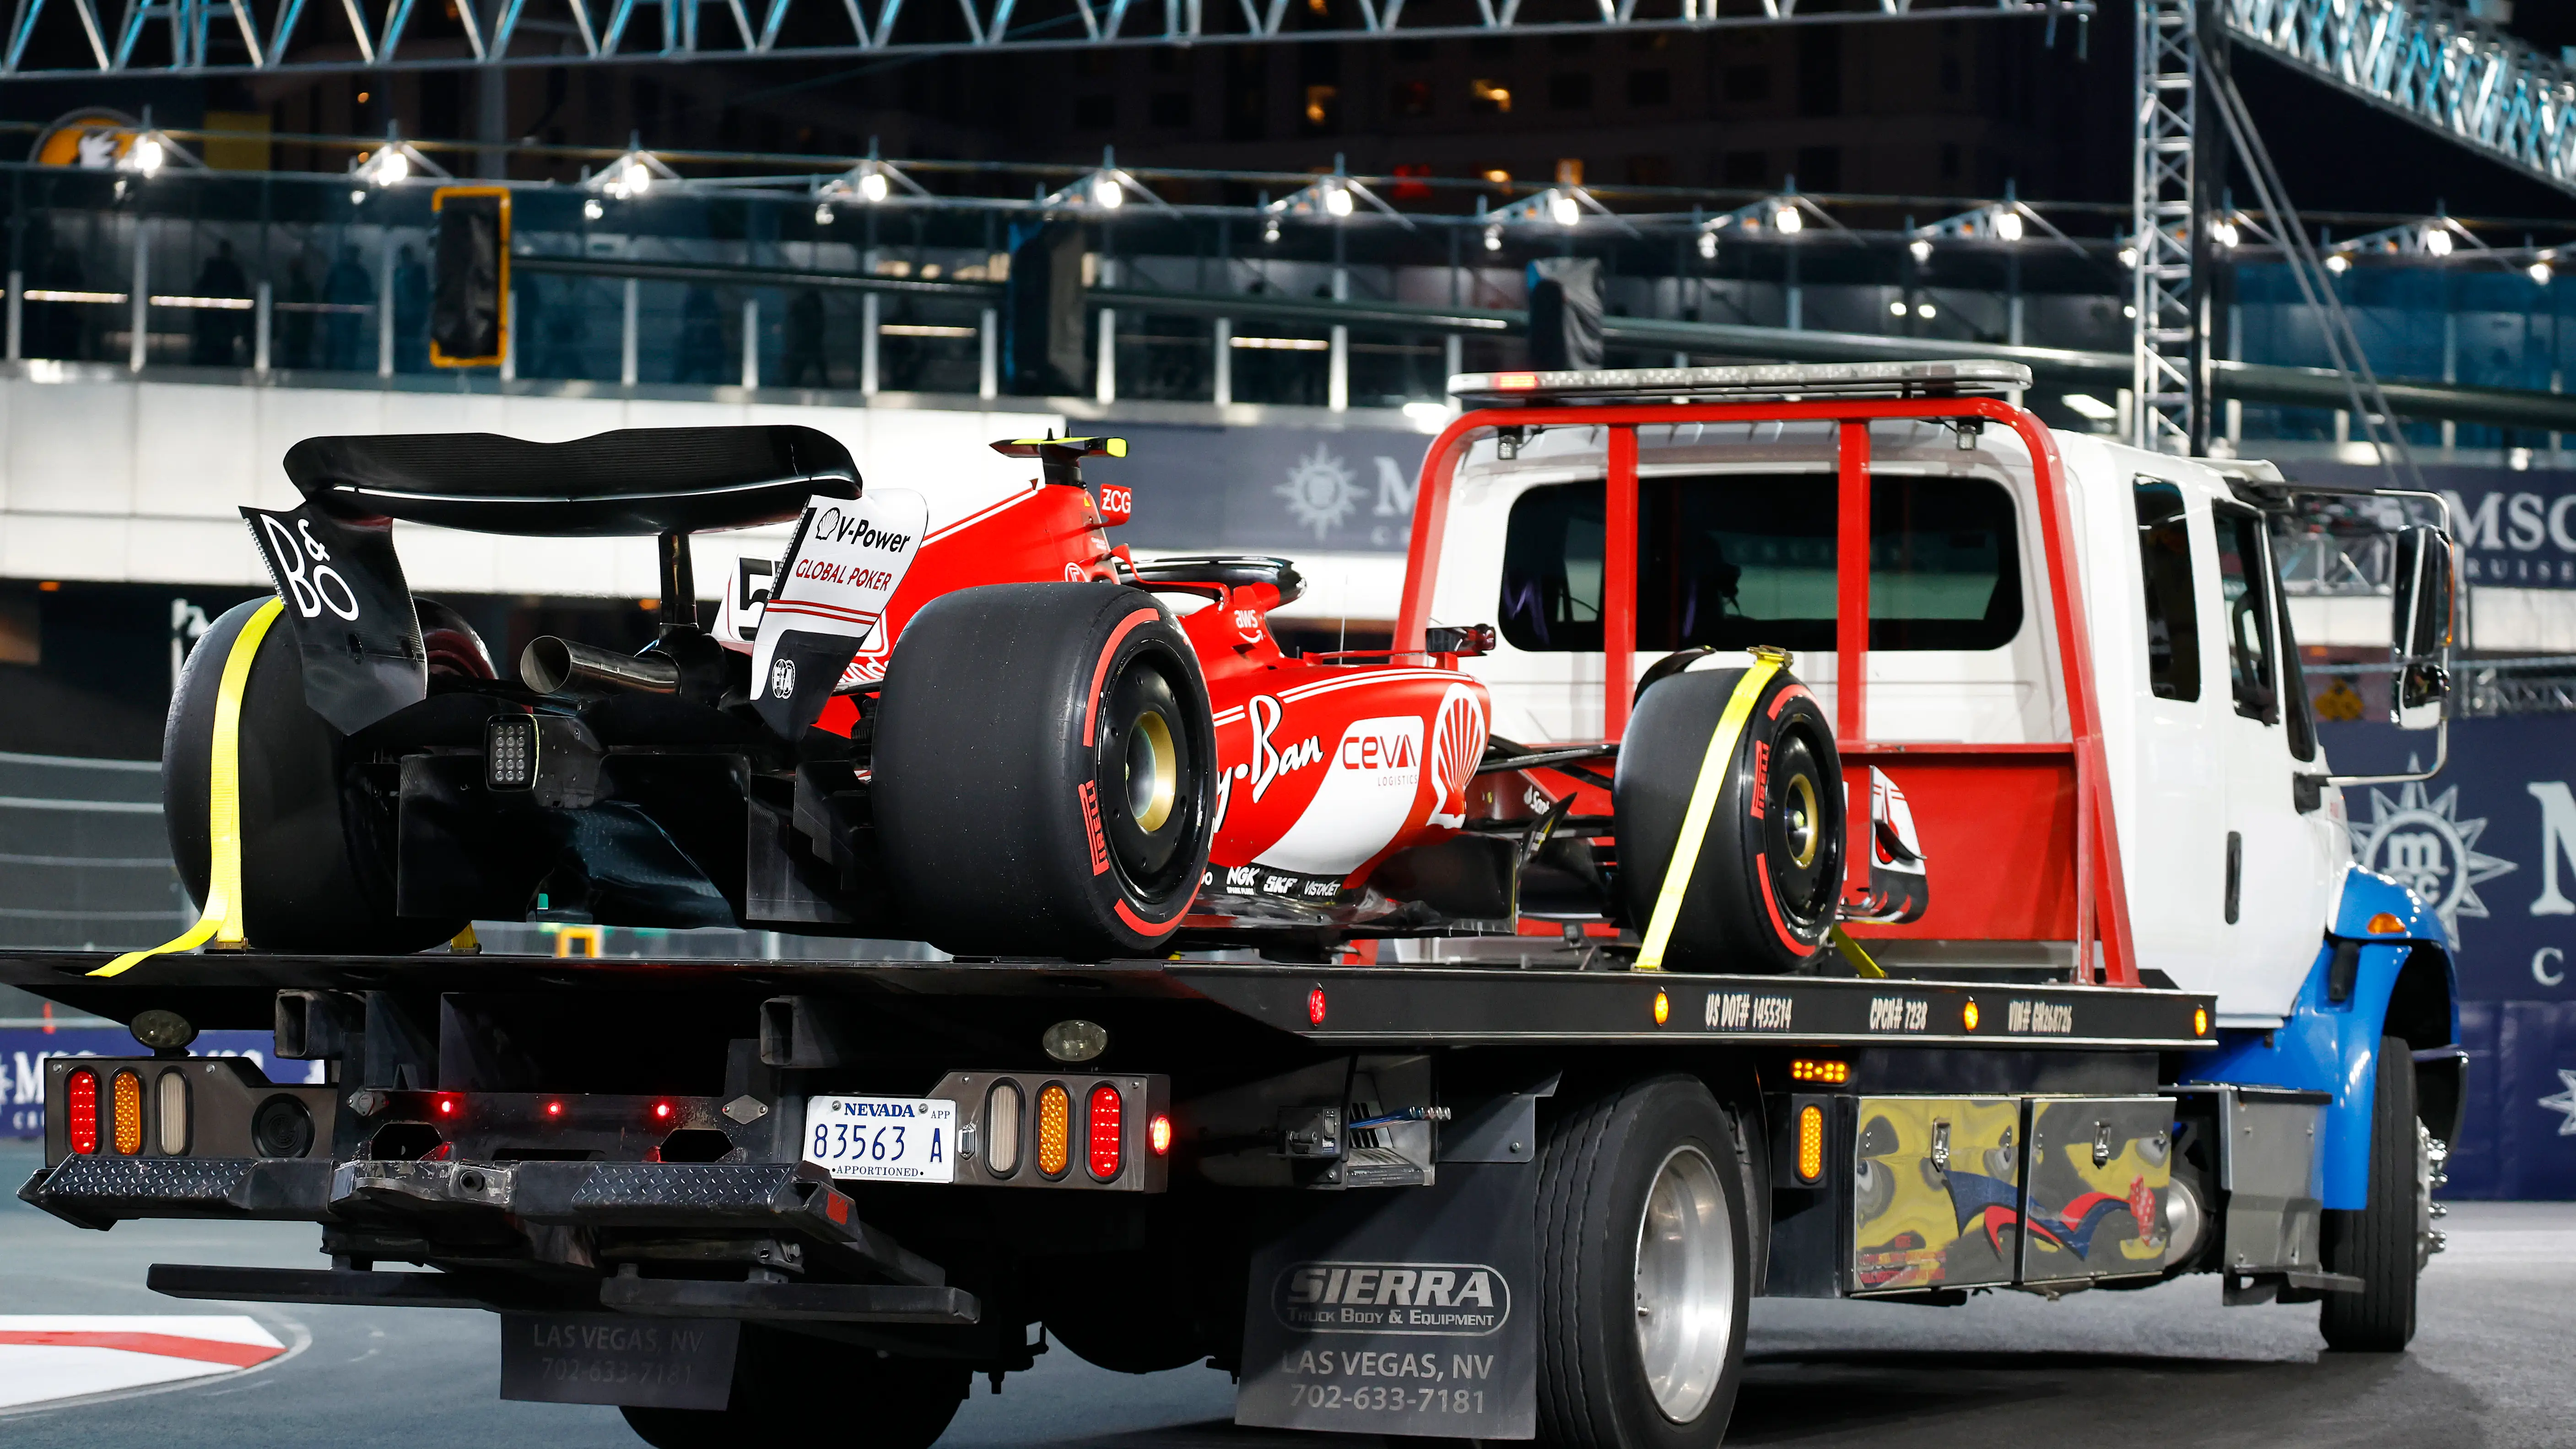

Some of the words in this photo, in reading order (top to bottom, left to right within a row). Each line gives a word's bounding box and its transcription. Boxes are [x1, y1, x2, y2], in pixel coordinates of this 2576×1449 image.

[1102, 488, 1131, 514] ZCG
[837, 516, 911, 552] V-Power
[796, 559, 847, 584] GLOBAL
[847, 568, 892, 591] POKER
[1235, 609, 1258, 629] aws
[1378, 774, 1418, 787] LOGISTICS
[1078, 779, 1110, 876] PIRELLI
[1226, 866, 1260, 886] NGK
[1263, 875, 1298, 893] SKF
[1705, 993, 1720, 1027] US
[1721, 993, 1750, 1027] DOT#
[1752, 997, 1793, 1029] 1455314
[844, 1103, 915, 1117] NEVADA
[931, 1110, 950, 1119] APP
[814, 1123, 906, 1161] 83563
[930, 1128, 942, 1162] A
[837, 1166, 918, 1177] APPORTIONED
[1288, 1269, 1494, 1308] SIERRA
[1389, 1310, 1404, 1325] &
[534, 1324, 576, 1348] LAS
[670, 1330, 704, 1353] NV
[1281, 1351, 1334, 1375] LAS
[1341, 1352, 1444, 1382] VEGAS,
[1453, 1355, 1494, 1379] NV
[1290, 1384, 1483, 1414] 702-633-7181
